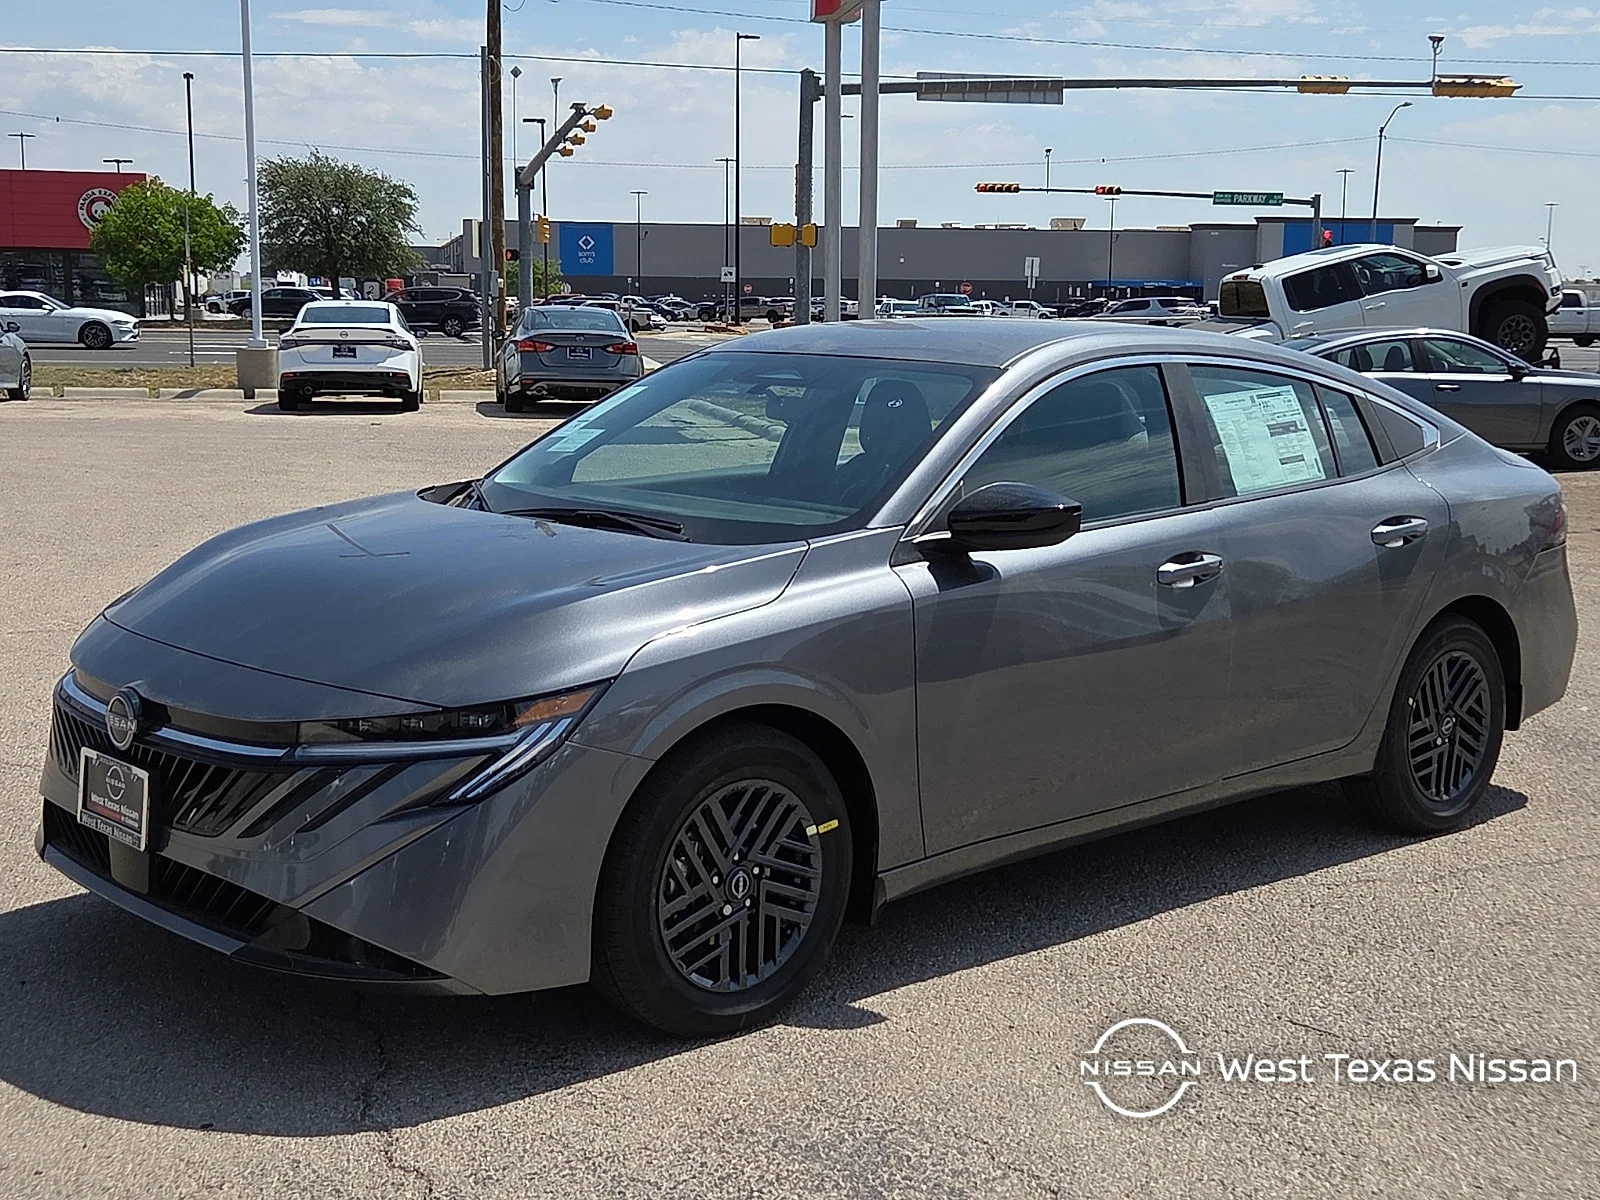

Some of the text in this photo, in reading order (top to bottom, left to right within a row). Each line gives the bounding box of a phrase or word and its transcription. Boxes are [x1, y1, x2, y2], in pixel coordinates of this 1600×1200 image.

[79, 190, 97, 211] PANDA
[1233, 194, 1267, 204] PARKWAY
[107, 713, 136, 732] SSAN
[105, 776, 126, 789] NISSAN
[90, 791, 105, 806] West
[104, 797, 120, 813] Texas
[120, 804, 139, 821] Nissan
[81, 812, 97, 829] West
[96, 819, 113, 835] Texas
[113, 826, 133, 846] Nissan
